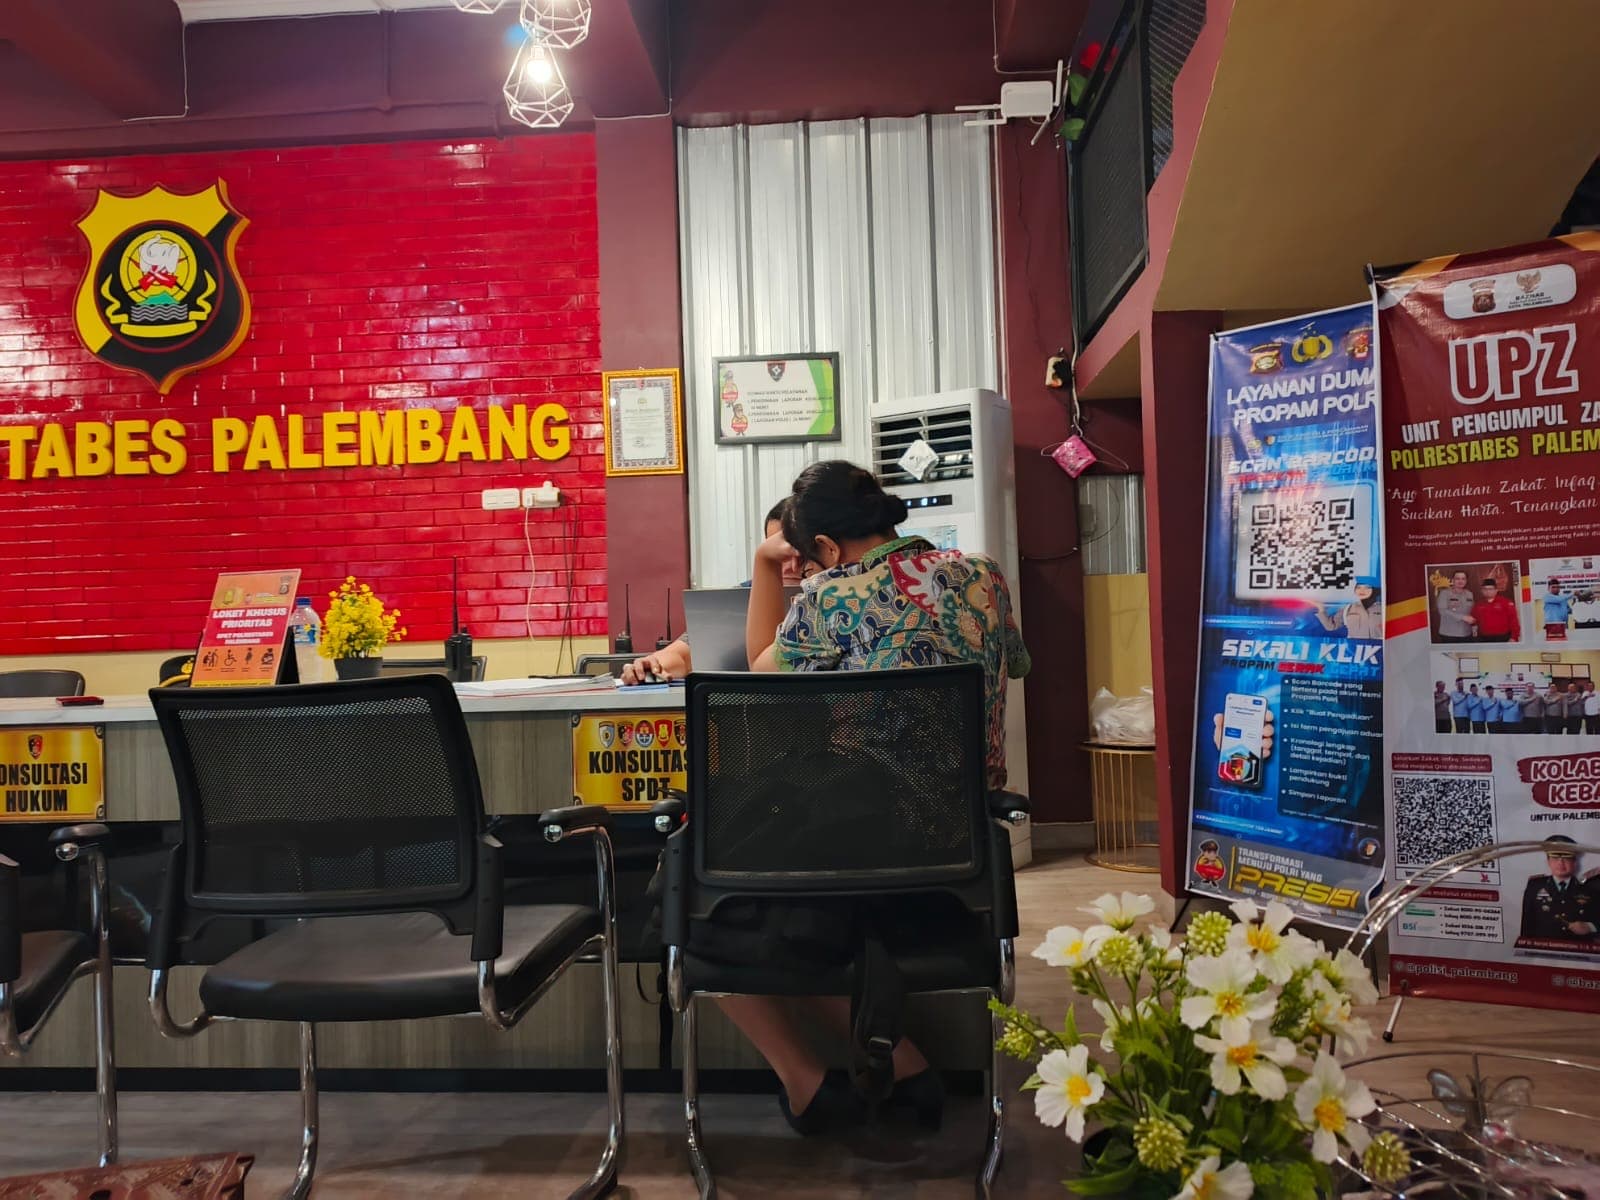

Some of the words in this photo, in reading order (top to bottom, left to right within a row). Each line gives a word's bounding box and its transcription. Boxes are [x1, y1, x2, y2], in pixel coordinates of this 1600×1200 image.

[1447, 323, 1579, 405] UPZ
[1226, 376, 1315, 405] LAYANAN
[1233, 399, 1318, 426] PROPAM
[1401, 420, 1441, 444] UNIT
[1452, 404, 1568, 437] PENGUMPUL
[0, 418, 188, 481] TABES
[212, 402, 572, 473] PALEMBANG
[1391, 436, 1520, 471] POLRESTABES
[1532, 428, 1600, 456] PALEM
[1283, 447, 1376, 469] BARCOD
[1423, 485, 1491, 500] Tunaikan
[1401, 507, 1453, 520] Sucikan
[1511, 496, 1598, 516] Tenangkan
[246, 607, 287, 617] KHUSUS
[221, 619, 273, 629] PRIORITAS
[1221, 639, 1310, 661] SEKALI
[1319, 643, 1382, 664] KLIK
[1222, 658, 1276, 670] PROPAM
[1344, 682, 1364, 691] yang
[1319, 726, 1359, 736] pengajuan
[1354, 753, 1370, 761] dan
[1531, 757, 1600, 782] KOLAB
[1289, 775, 1330, 787] pendukung
[6, 789, 68, 812] HUKUM
[1288, 789, 1315, 800] Simpan
[1316, 793, 1347, 804] Laporan
[1530, 813, 1561, 822] UNTUK
[1238, 847, 1303, 868] TRANSFORMASI
[1238, 856, 1273, 872] MENUJU
[1273, 863, 1299, 876] POLRI
[1300, 868, 1323, 883] YANG
[1235, 866, 1361, 910] PRESISI
